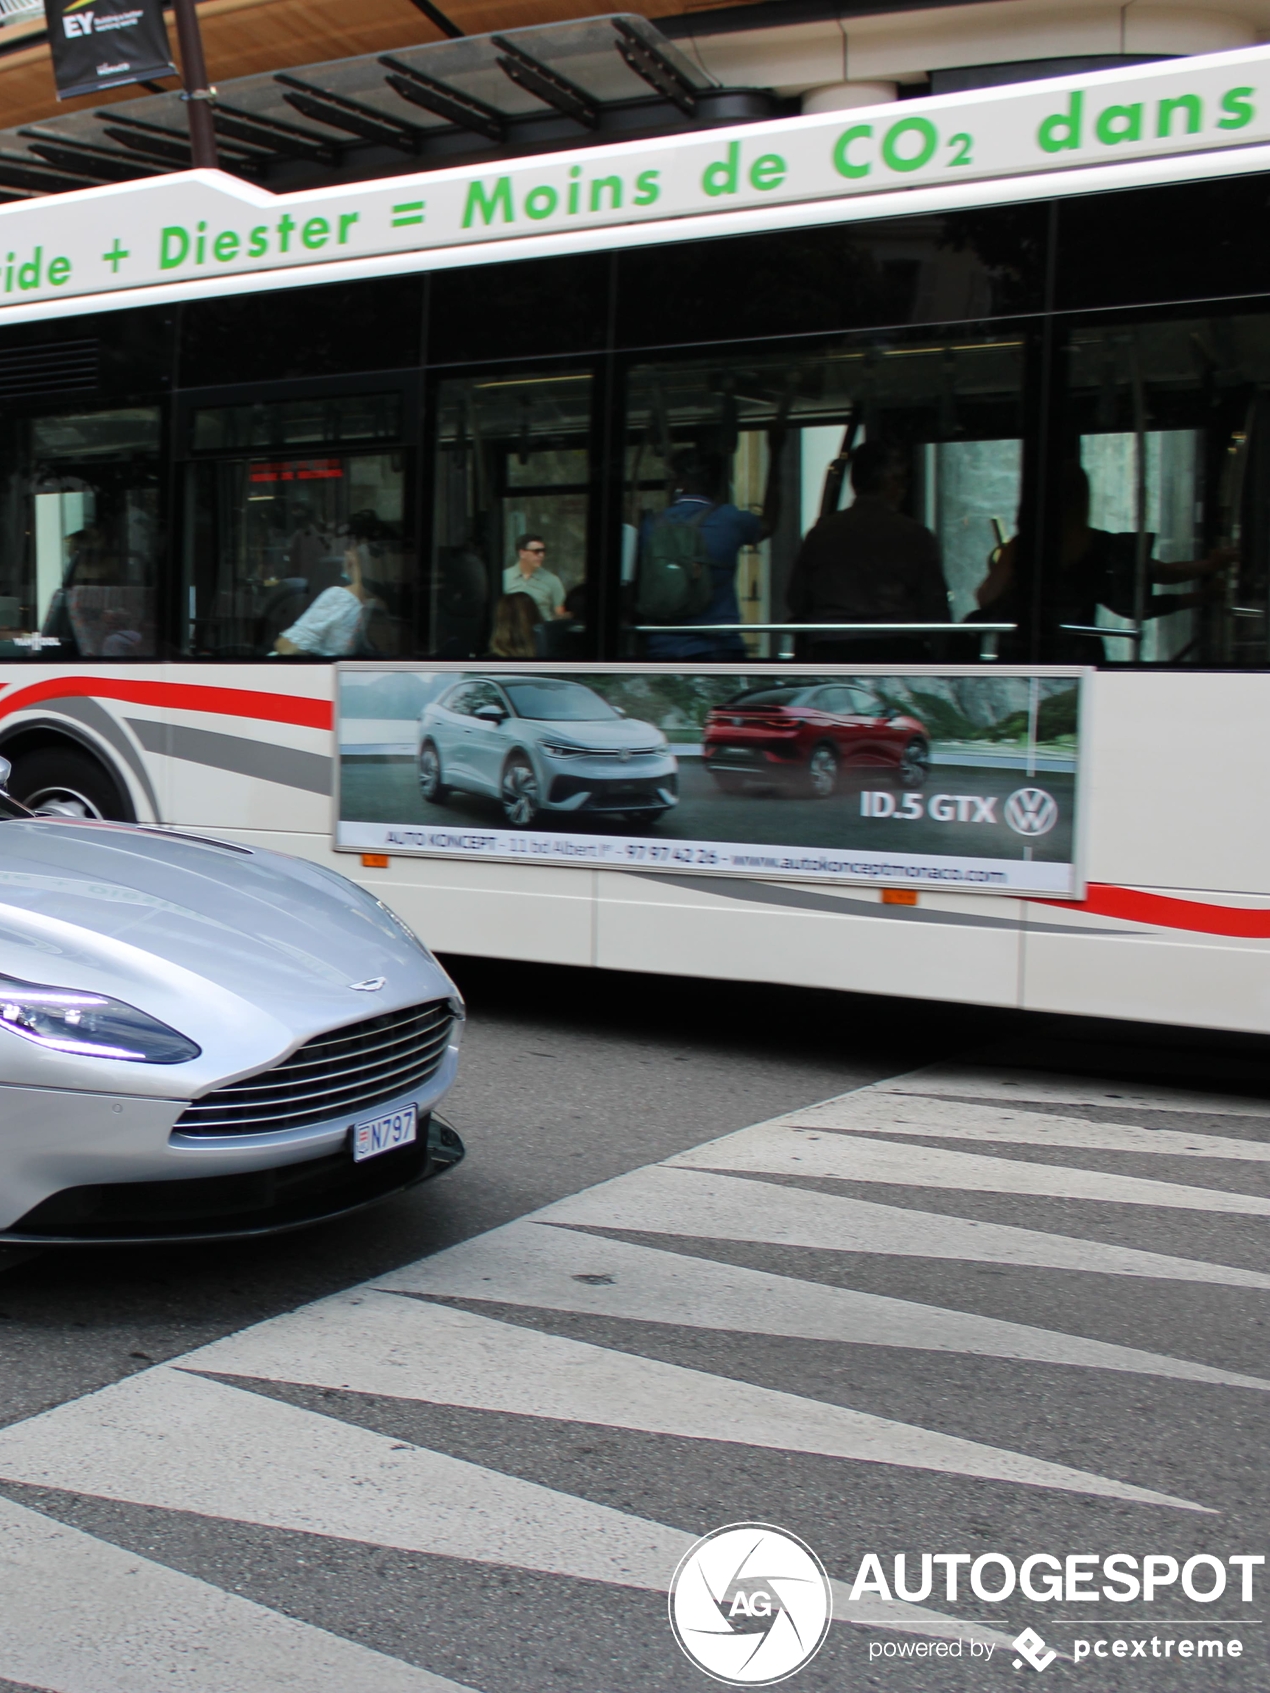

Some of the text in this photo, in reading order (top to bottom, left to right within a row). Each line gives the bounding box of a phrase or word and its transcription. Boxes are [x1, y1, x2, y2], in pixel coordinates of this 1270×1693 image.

[62, 11, 94, 38] EY
[159, 211, 359, 270] Diester
[461, 165, 662, 230] Moins
[701, 141, 787, 197] de
[1037, 86, 1257, 154] dans
[860, 791, 924, 820] ID.5
[930, 794, 998, 824] GTX
[386, 831, 425, 846] AUTO
[429, 834, 497, 850] KONCEPT
[626, 844, 646, 860] 97
[650, 846, 669, 861] 97
[673, 848, 692, 863] 42
[697, 849, 718, 864] 26
[730, 854, 1008, 884] www.autokonceptmonaco.com
[371, 1110, 414, 1151] N797
